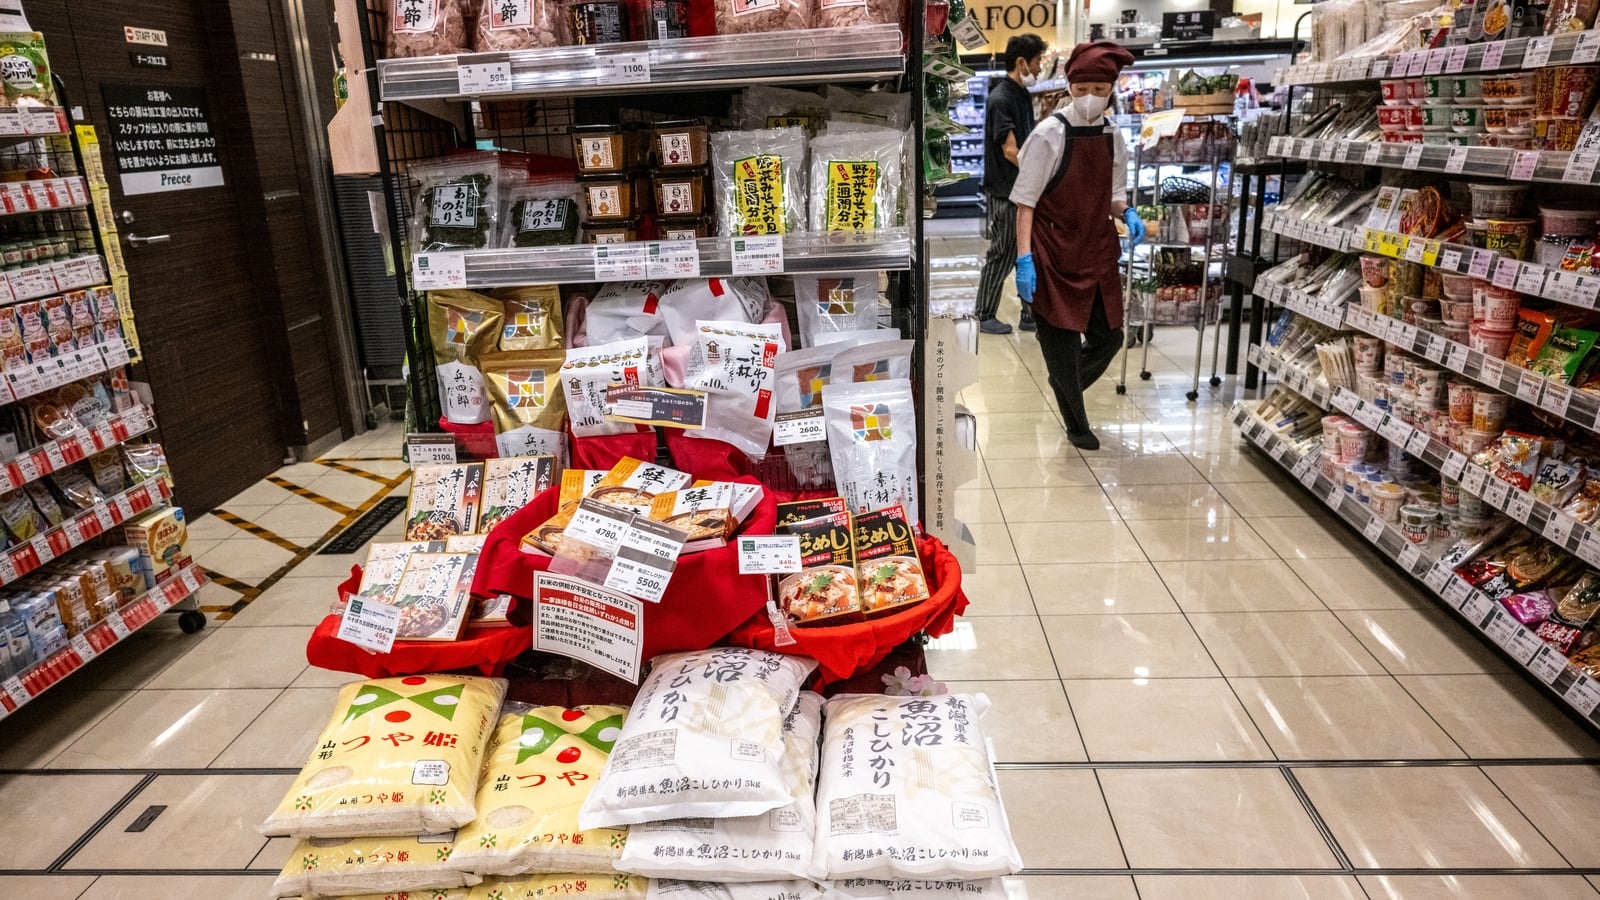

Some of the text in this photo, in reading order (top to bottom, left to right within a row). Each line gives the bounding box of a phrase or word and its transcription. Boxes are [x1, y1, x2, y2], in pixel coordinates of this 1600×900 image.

[135, 31, 150, 42] STAFF
[147, 91, 172, 102] お客様へ
[160, 173, 192, 186] Precce
[442, 202, 454, 225] のり
[454, 187, 466, 222] あおさ
[543, 200, 556, 226] あおさ
[532, 210, 544, 228] のり
[736, 356, 752, 380] 一杯
[800, 529, 849, 556] こめし
[855, 521, 908, 550] こめし
[539, 578, 636, 612] お米の供給が不安定となっております。
[573, 594, 607, 611] お米の販売は
[540, 605, 568, 614] となります。
[660, 653, 701, 724] こしひかり
[899, 699, 944, 747] 魚沼
[945, 696, 970, 745] 新潟県産
[318, 740, 336, 760] 山形
[342, 731, 460, 753] つや姫
[868, 707, 896, 789] こしひかり
[493, 774, 511, 791] 山形
[516, 770, 600, 789] つや
